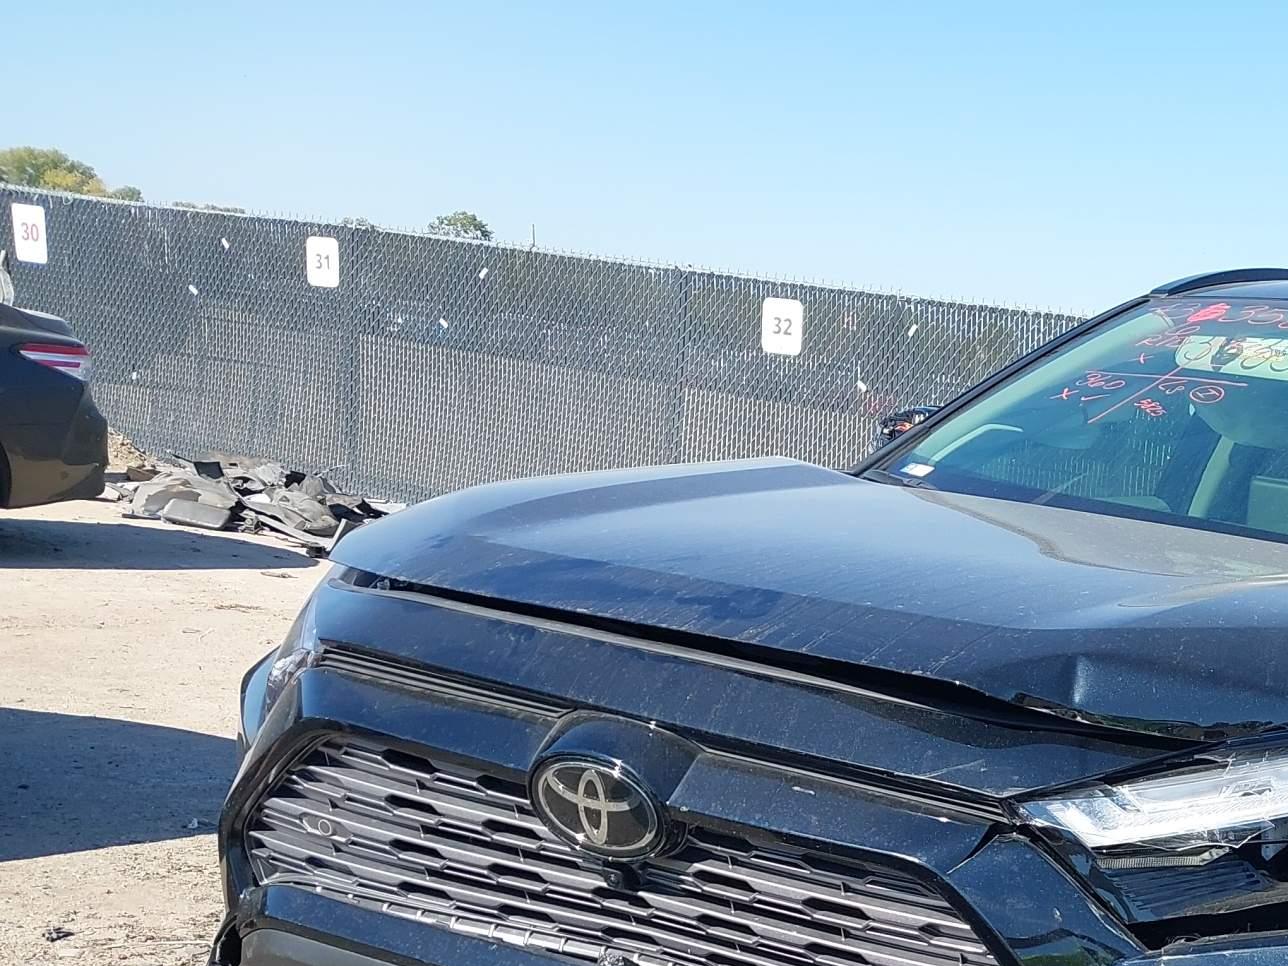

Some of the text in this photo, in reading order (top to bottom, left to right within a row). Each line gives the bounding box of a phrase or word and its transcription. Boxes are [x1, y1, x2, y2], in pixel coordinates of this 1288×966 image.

[21, 221, 40, 242] 30
[315, 253, 331, 271] 31
[772, 316, 793, 336] 32
